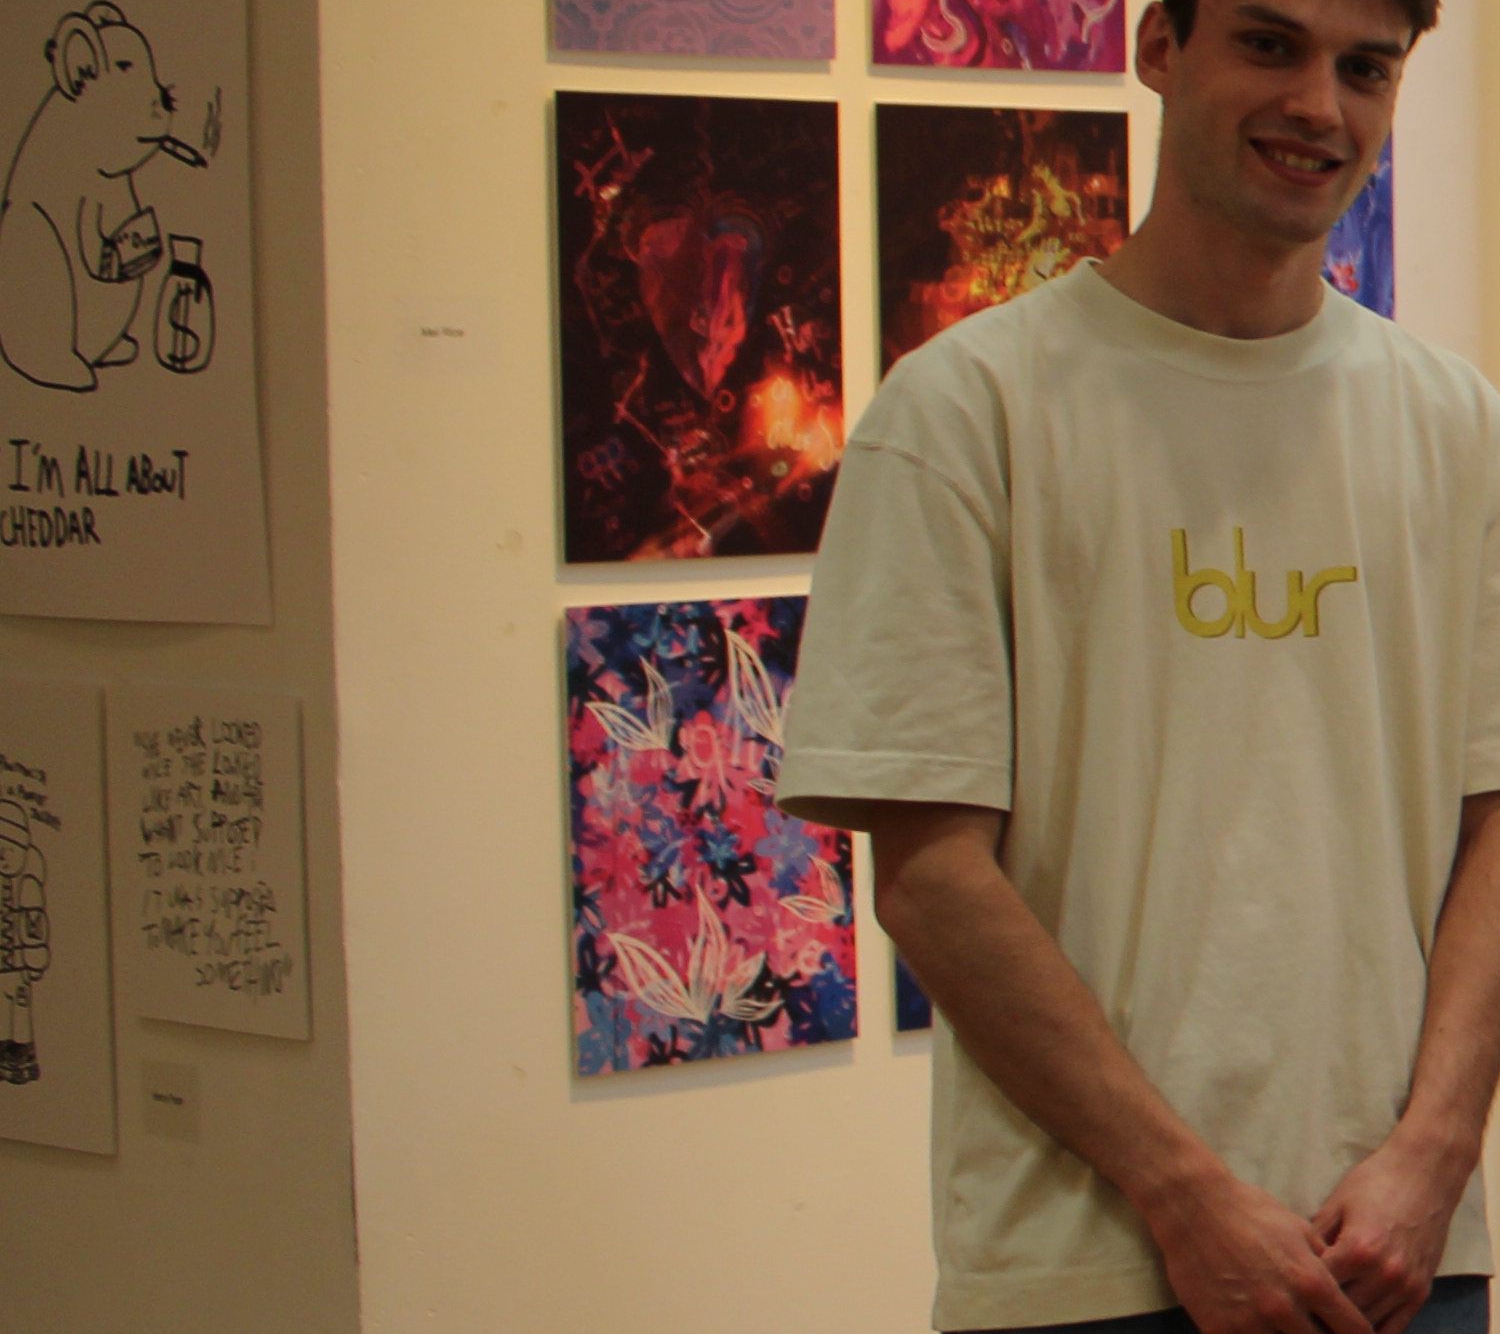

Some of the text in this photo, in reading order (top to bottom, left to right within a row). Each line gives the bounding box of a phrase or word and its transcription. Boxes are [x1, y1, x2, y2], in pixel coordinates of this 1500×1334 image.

[75, 444, 120, 497] ALL
[0, 505, 102, 548] CHEDDAR
[1171, 526, 1358, 640] blur
